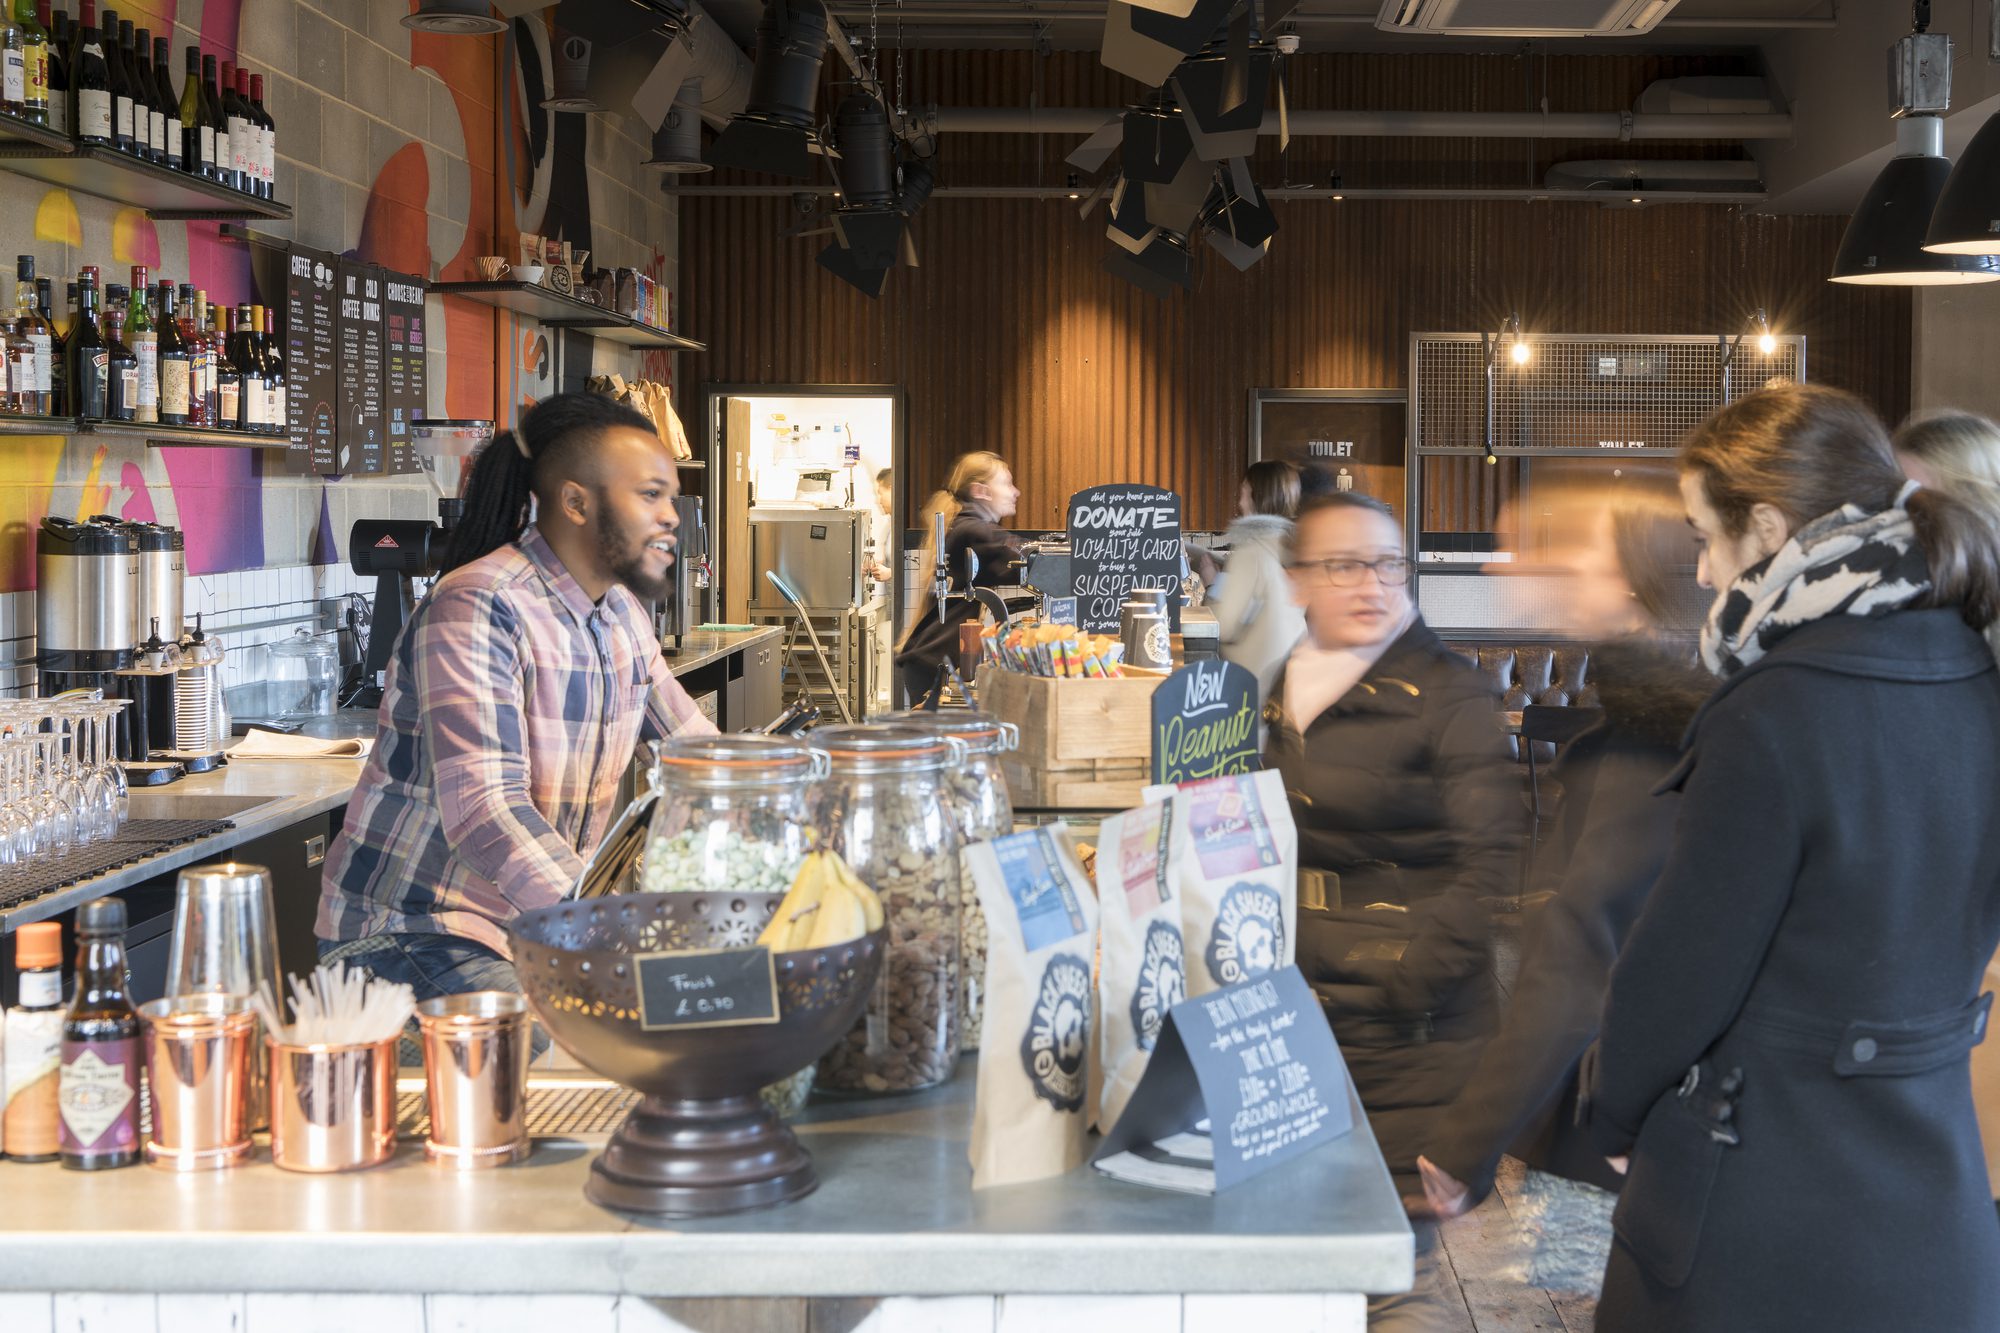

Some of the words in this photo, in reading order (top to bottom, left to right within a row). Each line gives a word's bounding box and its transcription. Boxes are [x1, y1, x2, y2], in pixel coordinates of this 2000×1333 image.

[7, 77, 18, 86] VS
[292, 255, 311, 279] COFFEE
[342, 298, 360, 320] COFFEE
[1308, 441, 1354, 457] TOILET
[1091, 492, 1105, 503] did
[1109, 494, 1126, 504] you
[1073, 505, 1178, 529] DONATE
[1074, 538, 1140, 560] LOYALTY
[1142, 538, 1180, 561] CARD
[1098, 561, 1109, 572] to
[1109, 561, 1126, 573] buy
[1073, 574, 1179, 596] SUSPENDED
[1090, 597, 1129, 618] COF
[1083, 618, 1096, 630] for
[1184, 661, 1229, 710] NEW
[1160, 691, 1256, 785] Peanut
[1215, 898, 1243, 961] BLACK
[1234, 890, 1279, 920] SHEEP
[1139, 939, 1161, 1010] BLACK
[1031, 974, 1060, 1051] BLACK
[1052, 963, 1089, 999] SHEEP
